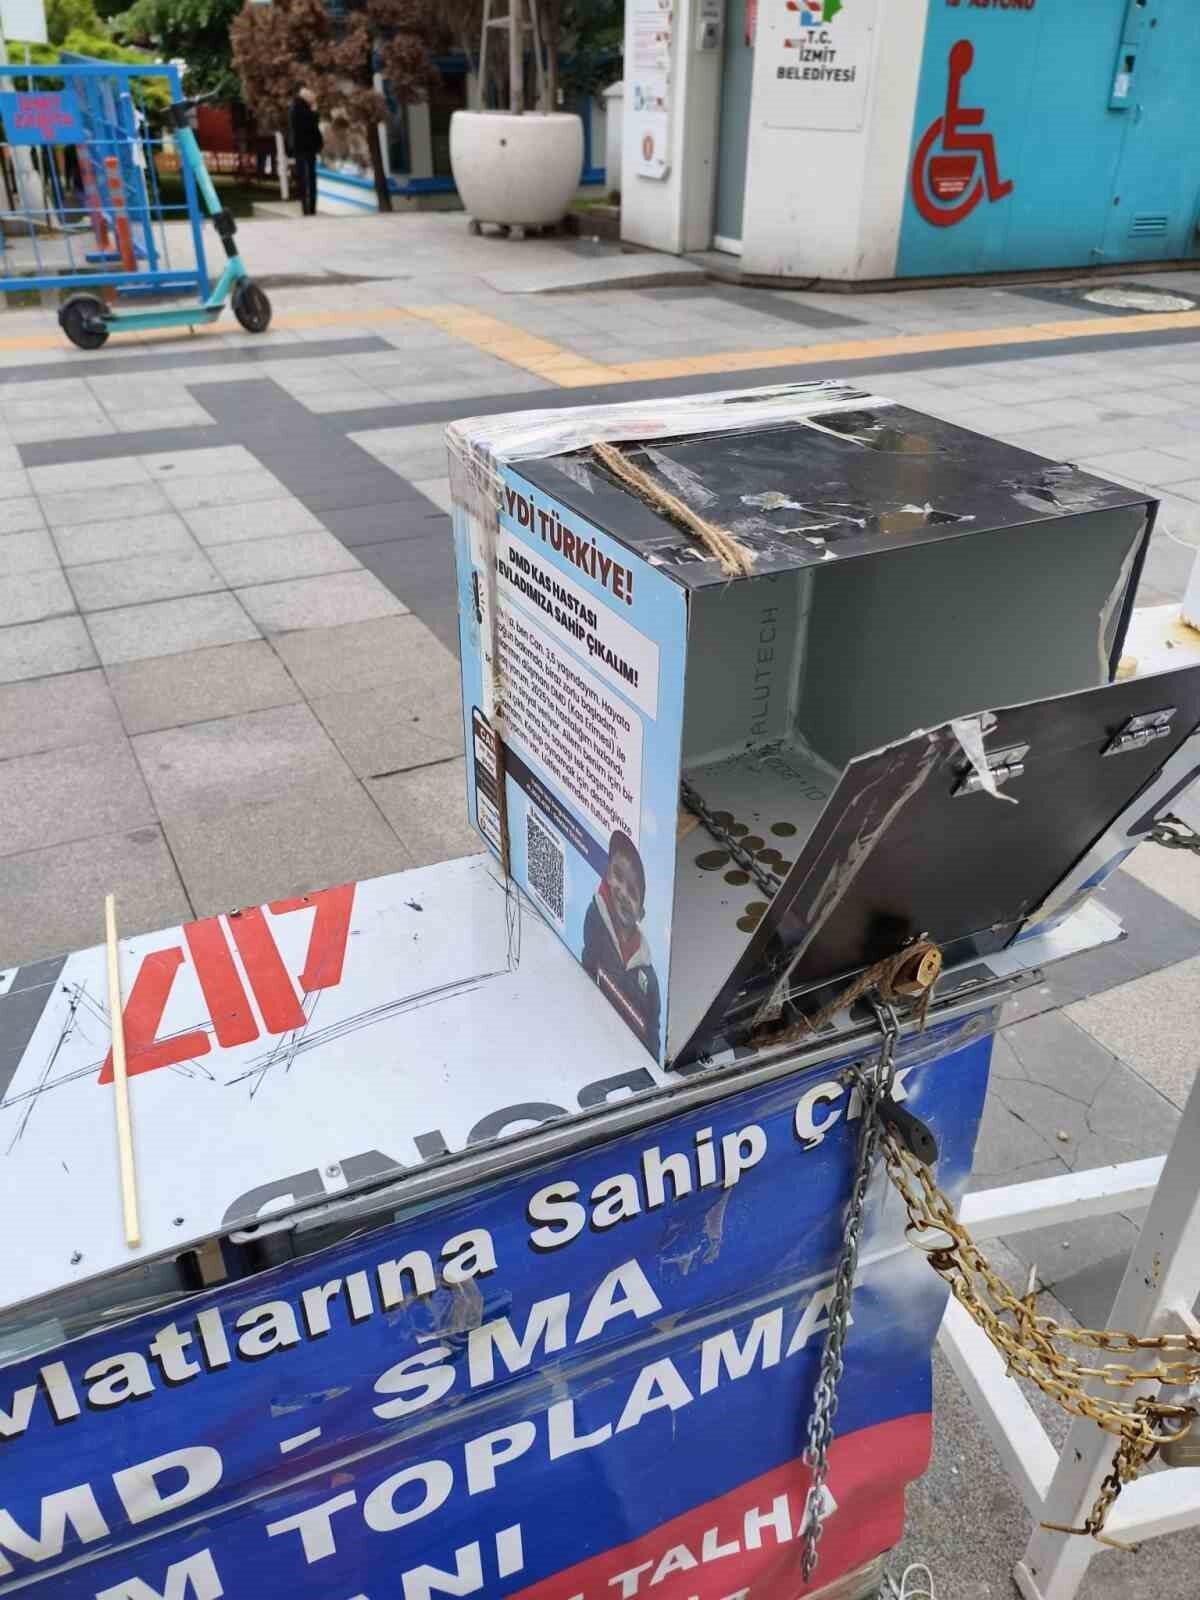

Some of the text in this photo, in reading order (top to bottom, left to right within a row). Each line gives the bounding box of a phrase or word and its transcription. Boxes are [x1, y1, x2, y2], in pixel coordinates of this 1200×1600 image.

[777, 64, 856, 82] BELEDİYESİ
[799, 46, 836, 62] İZMİT
[509, 547, 596, 629] DMD KAS HASTASI
[537, 510, 633, 606] TÜRKİYE!
[499, 560, 553, 616] EVLADIMIZA
[555, 606, 585, 640] SAHİP
[586, 634, 638, 687] ÇIKALIM!
[751, 607, 779, 736] ALUTECH
[580, 696, 618, 738] başladım.
[601, 698, 630, 732] Hayata
[527, 1124, 767, 1247] Sahip
[372, 1258, 662, 1419] SMA
[266, 1282, 854, 1564] TOPLAMA
[608, 1484, 838, 1599] TALHA
